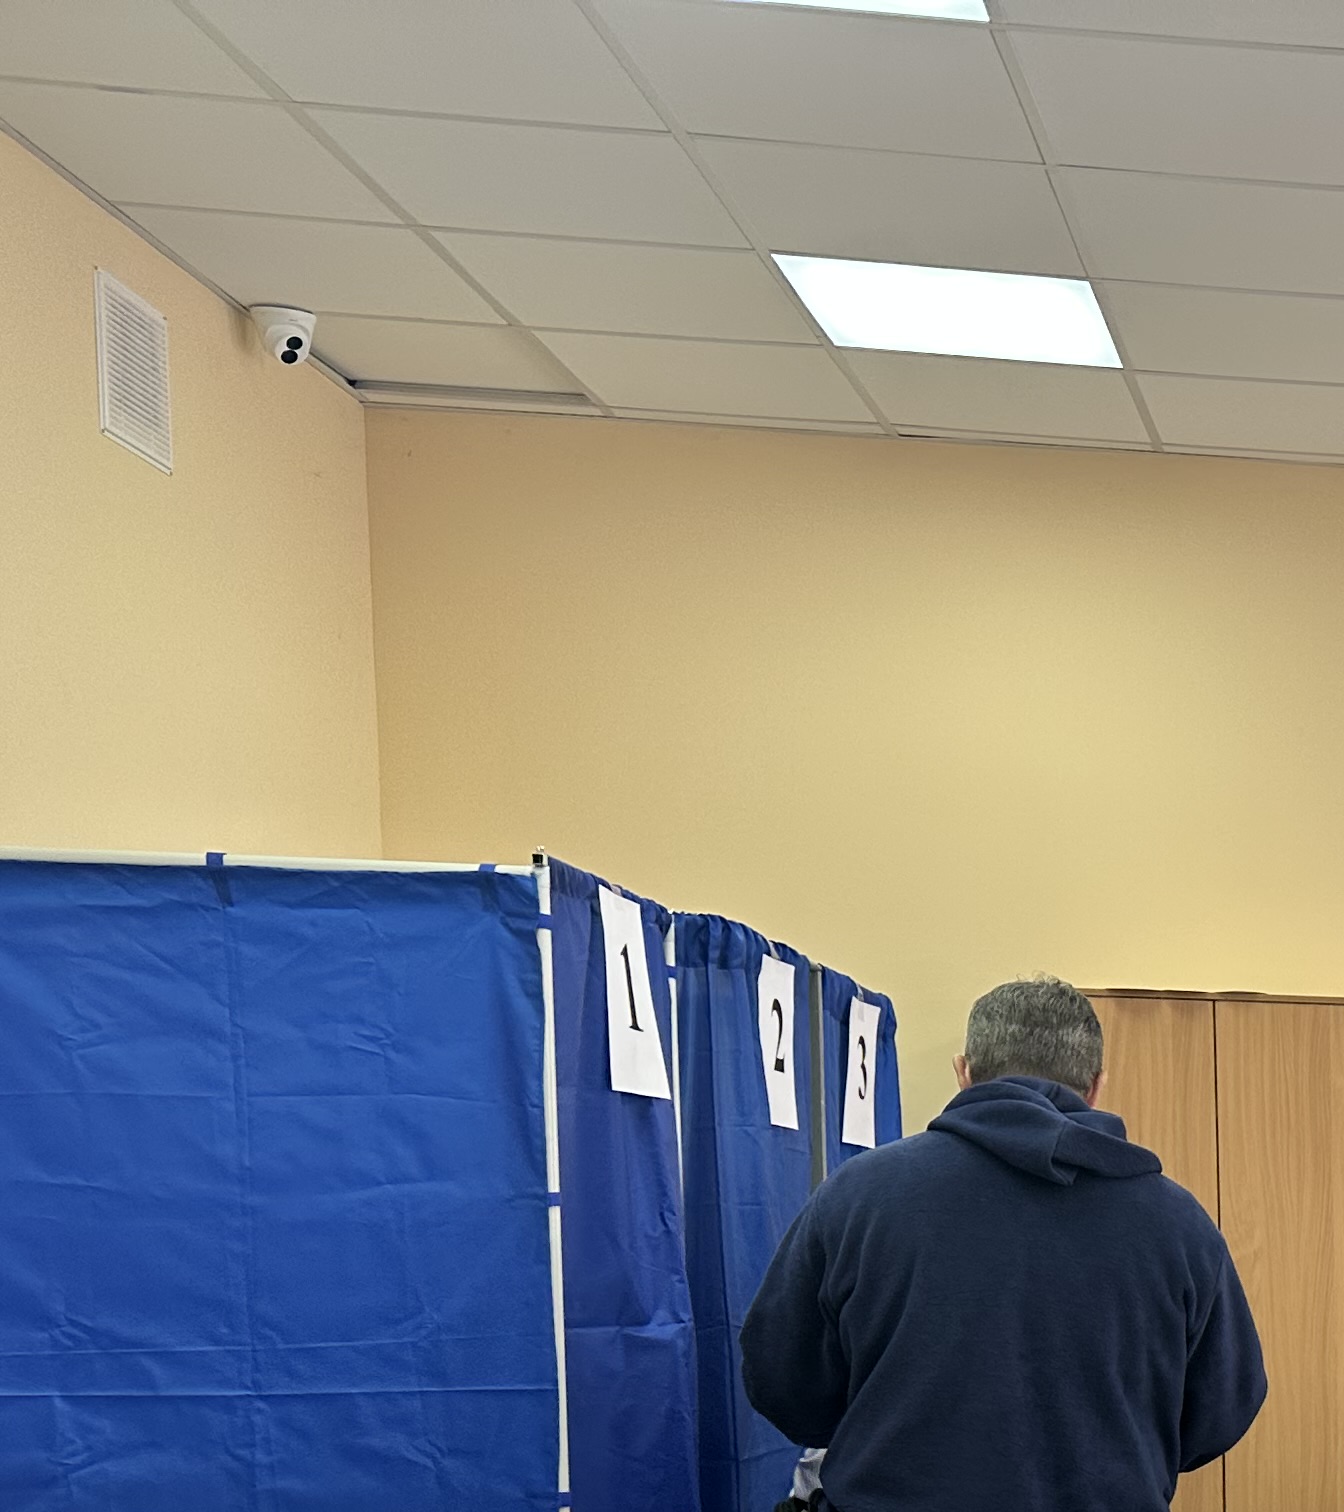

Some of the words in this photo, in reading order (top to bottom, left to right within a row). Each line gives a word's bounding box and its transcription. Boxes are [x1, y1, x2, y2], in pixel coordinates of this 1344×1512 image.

[620, 944, 643, 1032] 1
[771, 998, 785, 1073] 2
[857, 1035, 868, 1100] 3
